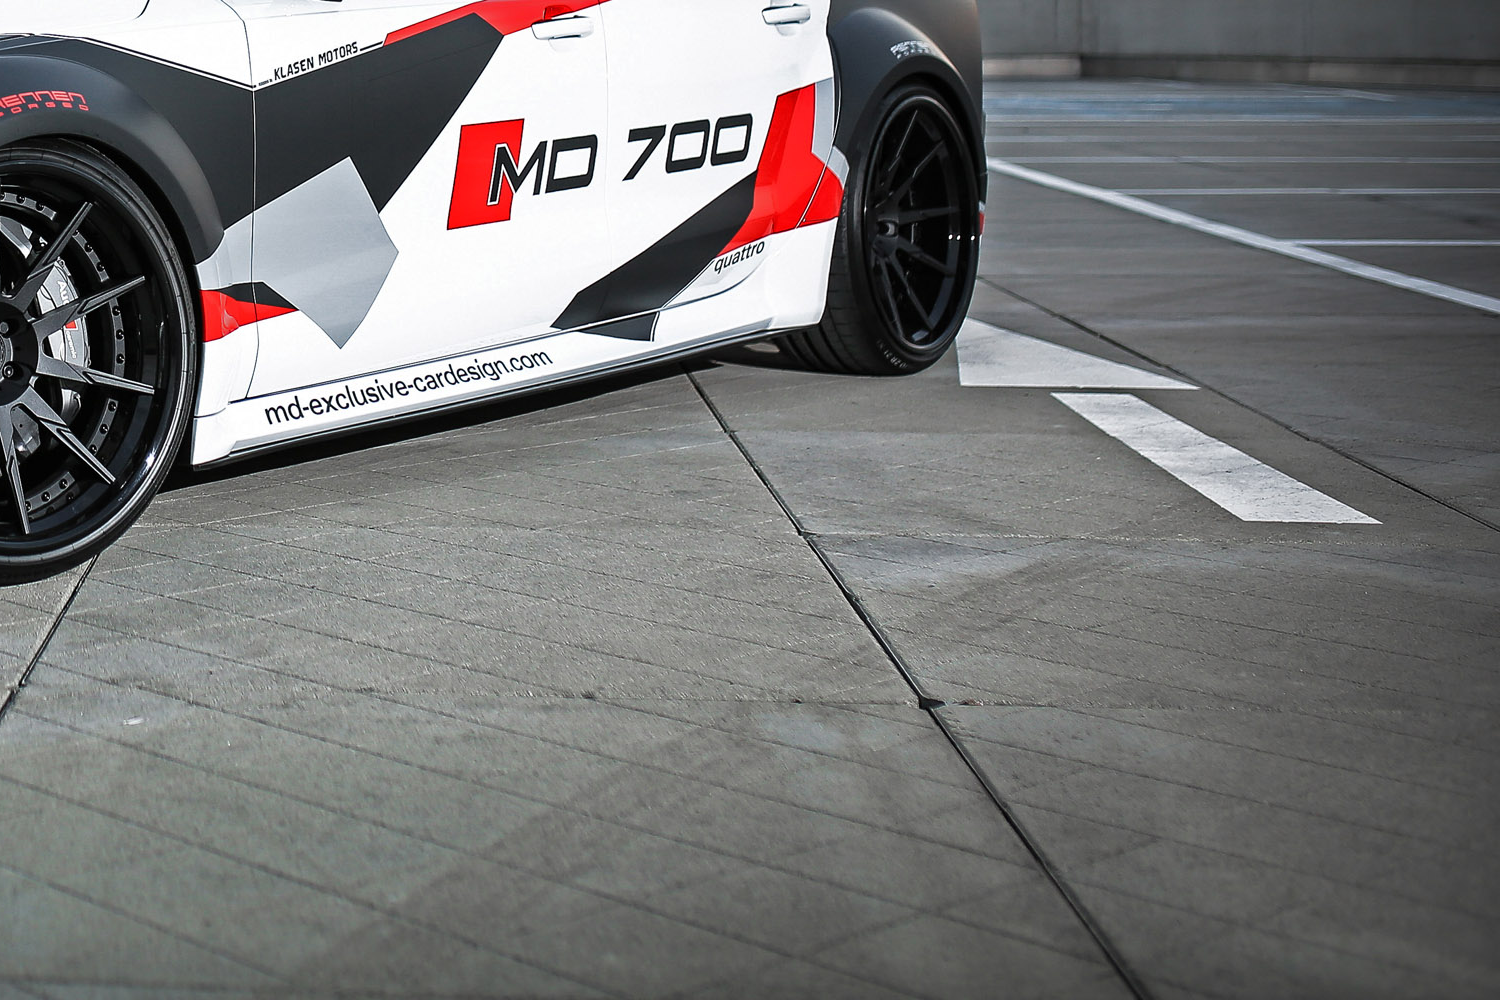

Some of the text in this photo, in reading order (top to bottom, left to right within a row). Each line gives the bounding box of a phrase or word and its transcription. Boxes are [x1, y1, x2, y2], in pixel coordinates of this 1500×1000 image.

[273, 41, 359, 81] KLASEN MOTORS
[486, 113, 753, 207] MD 700
[714, 241, 765, 275] quattro
[264, 349, 554, 426] md-exclusive-cardesign.com
